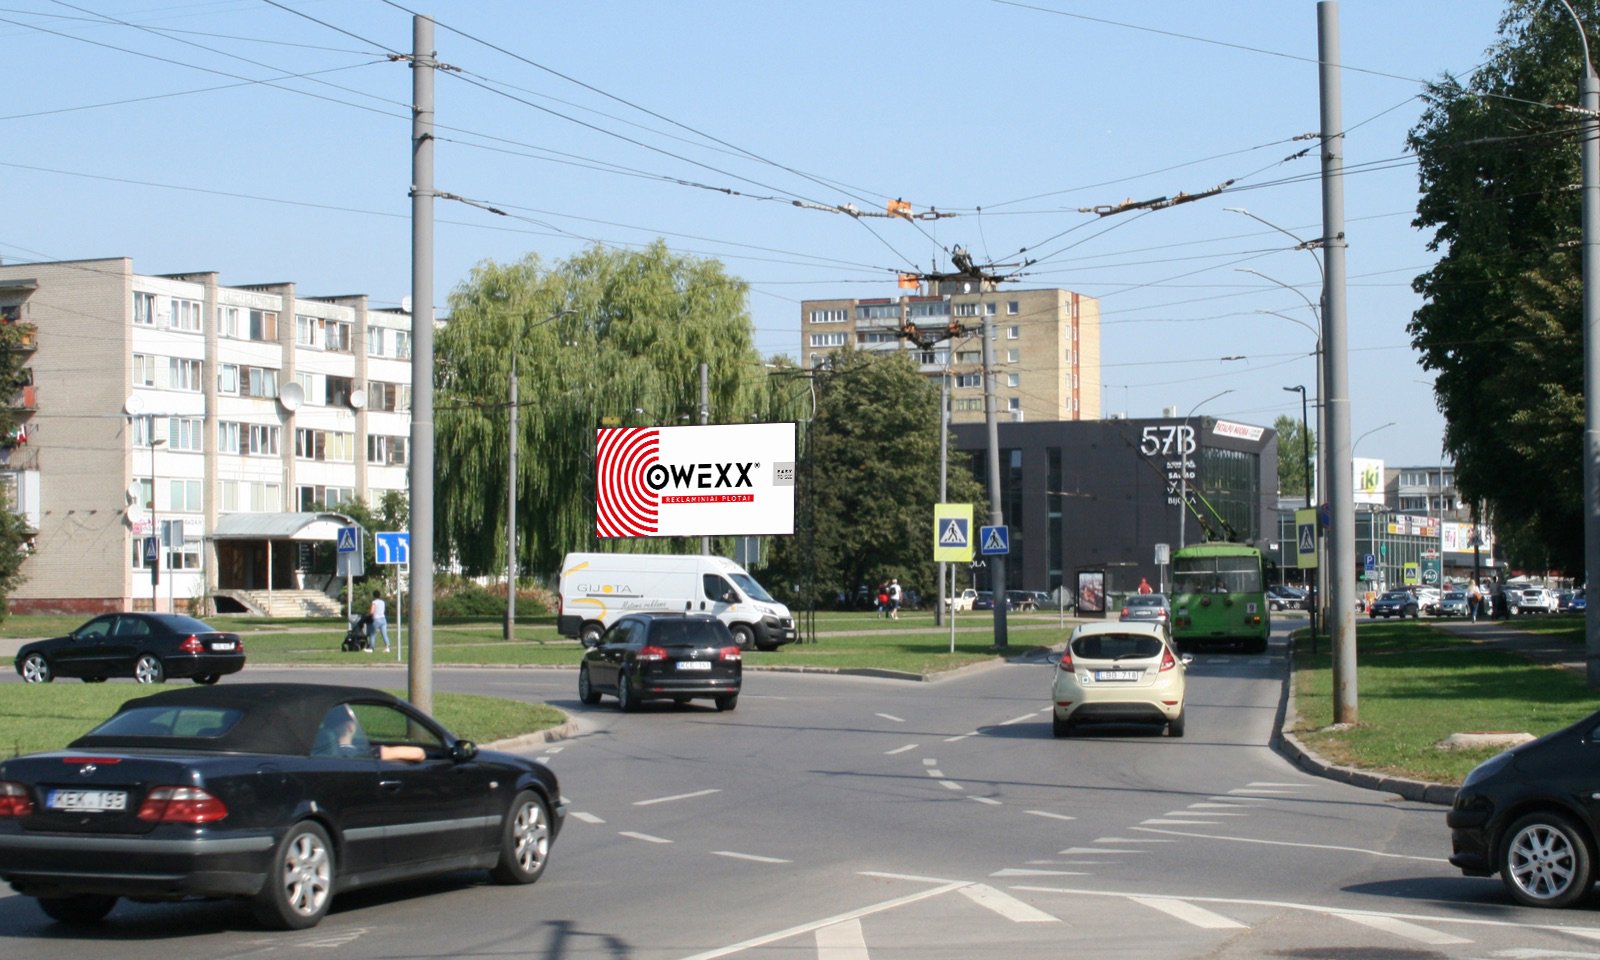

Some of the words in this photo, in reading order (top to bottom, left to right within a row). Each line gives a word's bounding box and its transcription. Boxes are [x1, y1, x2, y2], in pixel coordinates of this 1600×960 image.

[1140, 425, 1196, 456] 57B
[646, 462, 753, 490] OWEXX
[1360, 465, 1379, 490] iki
[56, 791, 88, 807] KEK
